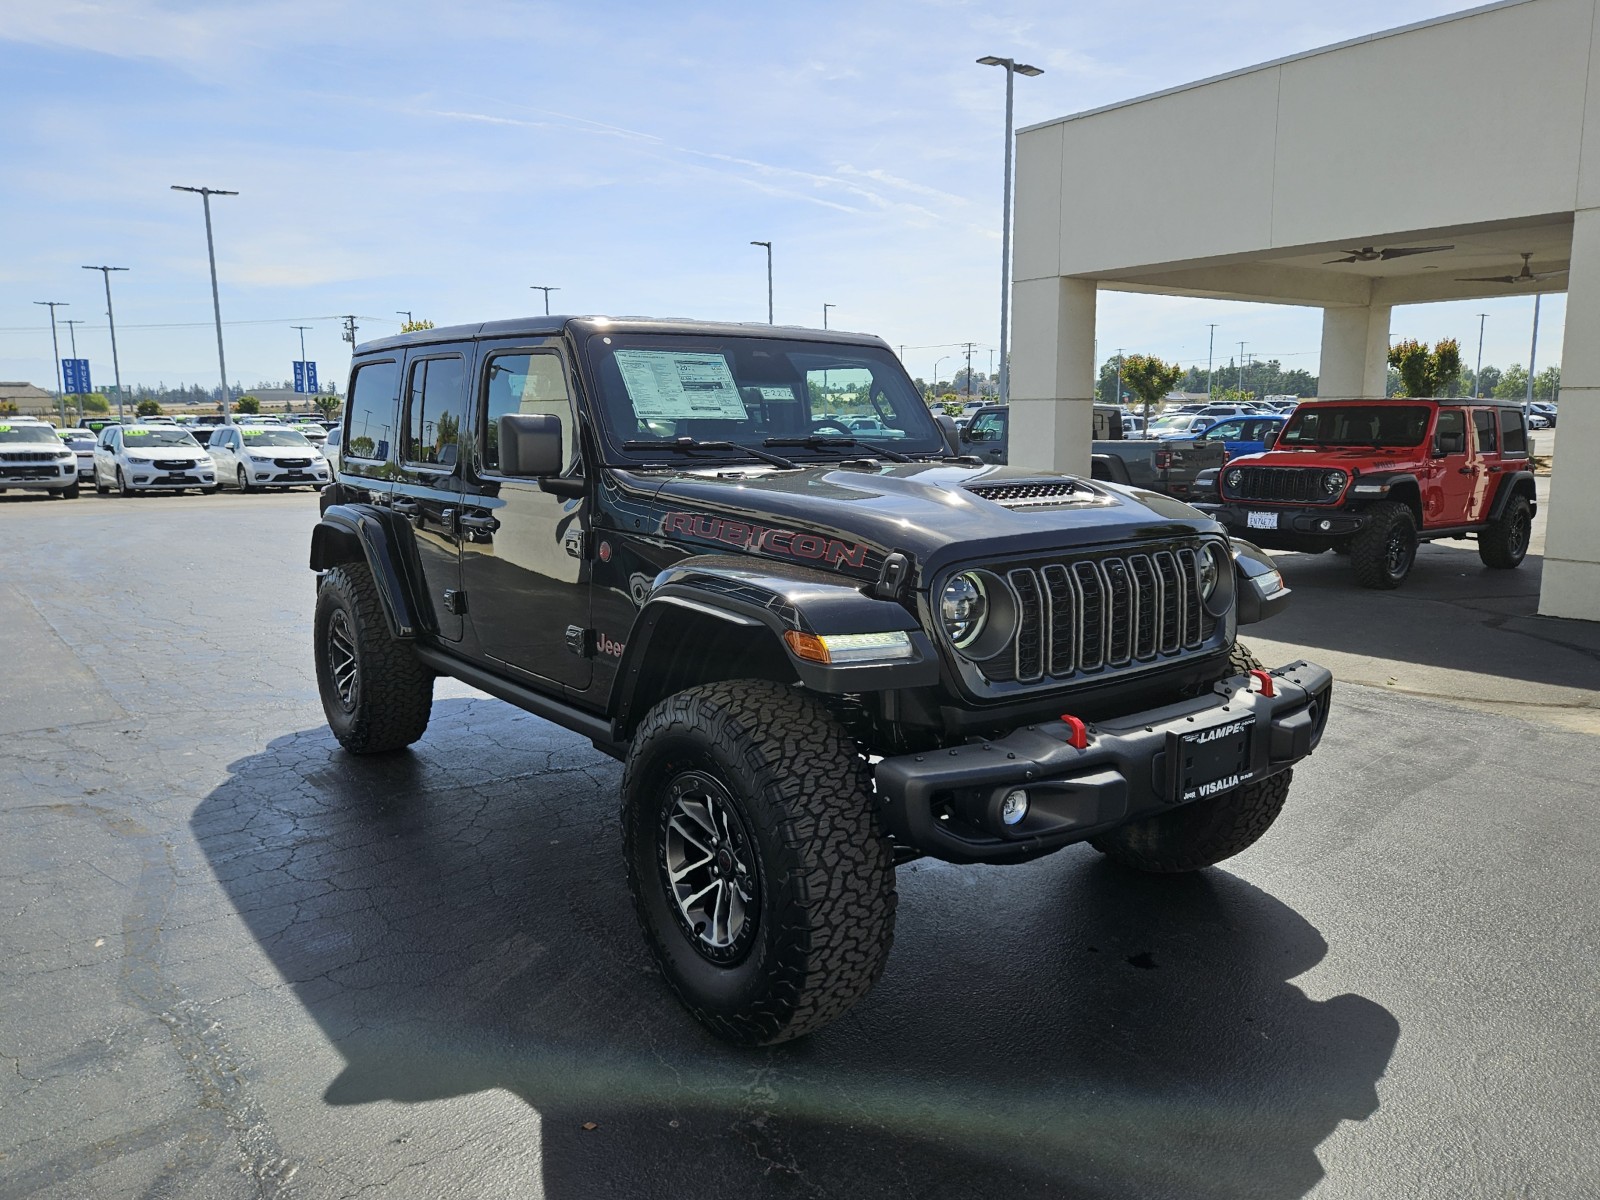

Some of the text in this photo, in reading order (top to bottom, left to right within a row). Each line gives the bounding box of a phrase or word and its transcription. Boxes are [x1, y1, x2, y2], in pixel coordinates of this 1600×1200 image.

[65, 360, 75, 392] USED
[80, 360, 88, 393] TRUCKS
[308, 363, 316, 391] CDJR
[665, 512, 868, 567] RUBICON
[1199, 722, 1241, 744] LAMPE
[1198, 774, 1239, 797] VISALIA
